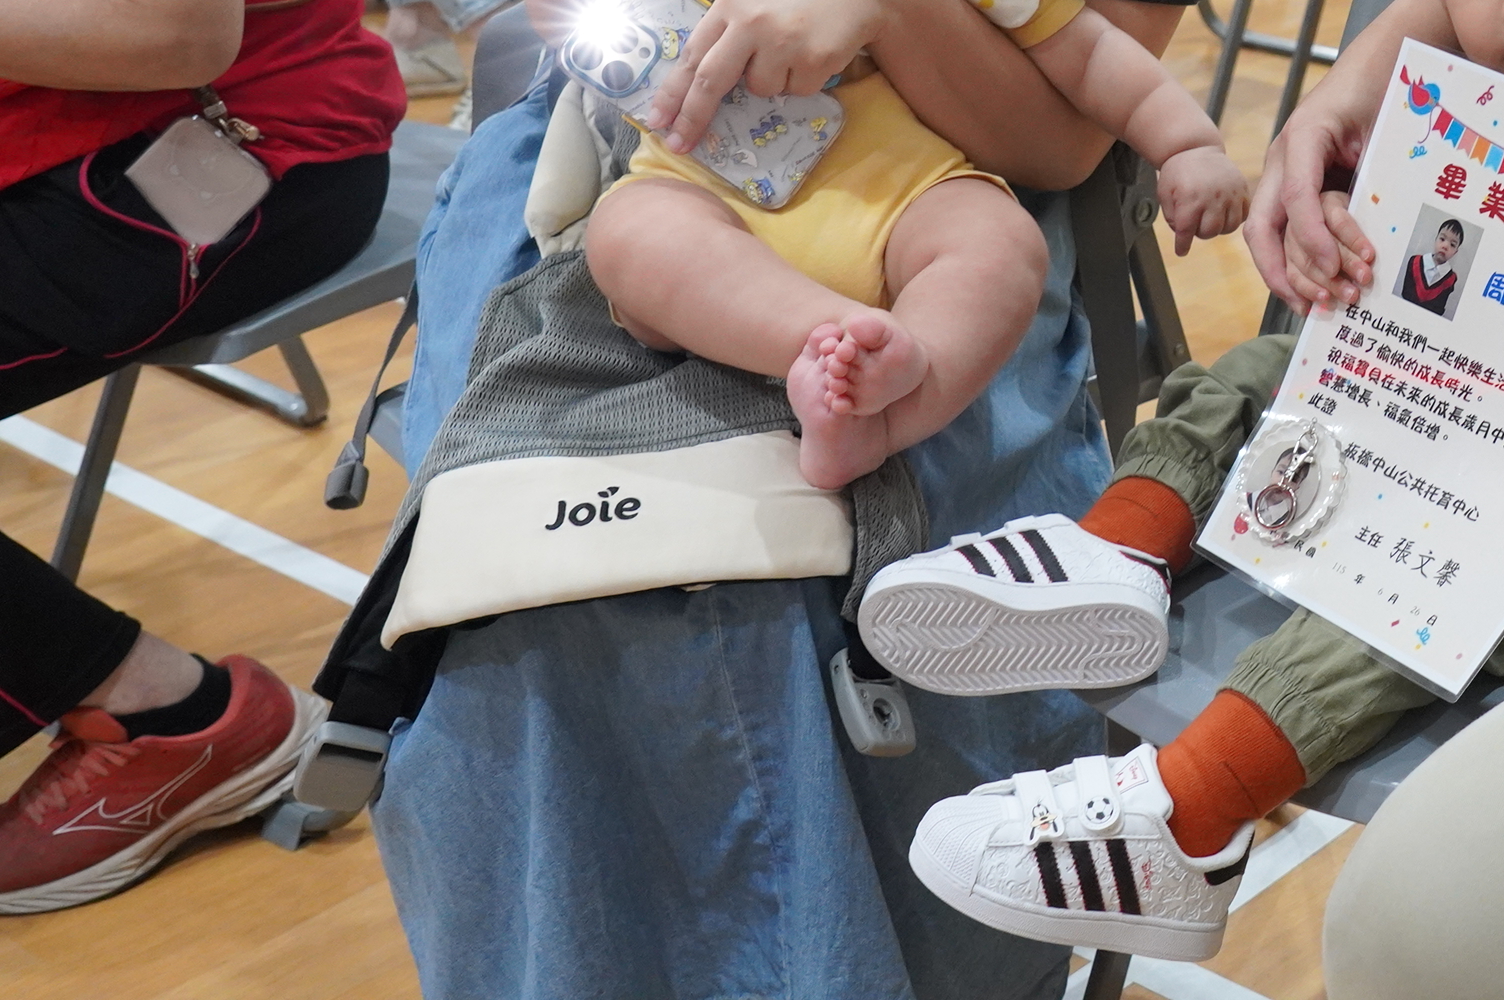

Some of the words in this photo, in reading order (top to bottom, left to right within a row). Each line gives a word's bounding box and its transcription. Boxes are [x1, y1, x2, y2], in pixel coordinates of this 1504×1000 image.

[1307, 392, 1338, 417] 此證
[1344, 441, 1481, 522] 板橋中山公共托育中心
[545, 486, 642, 531] Joie
[1354, 525, 1386, 549] 主任
[1353, 572, 1367, 586] 年
[1387, 592, 1400, 606] 月
[1426, 613, 1439, 627] 日
